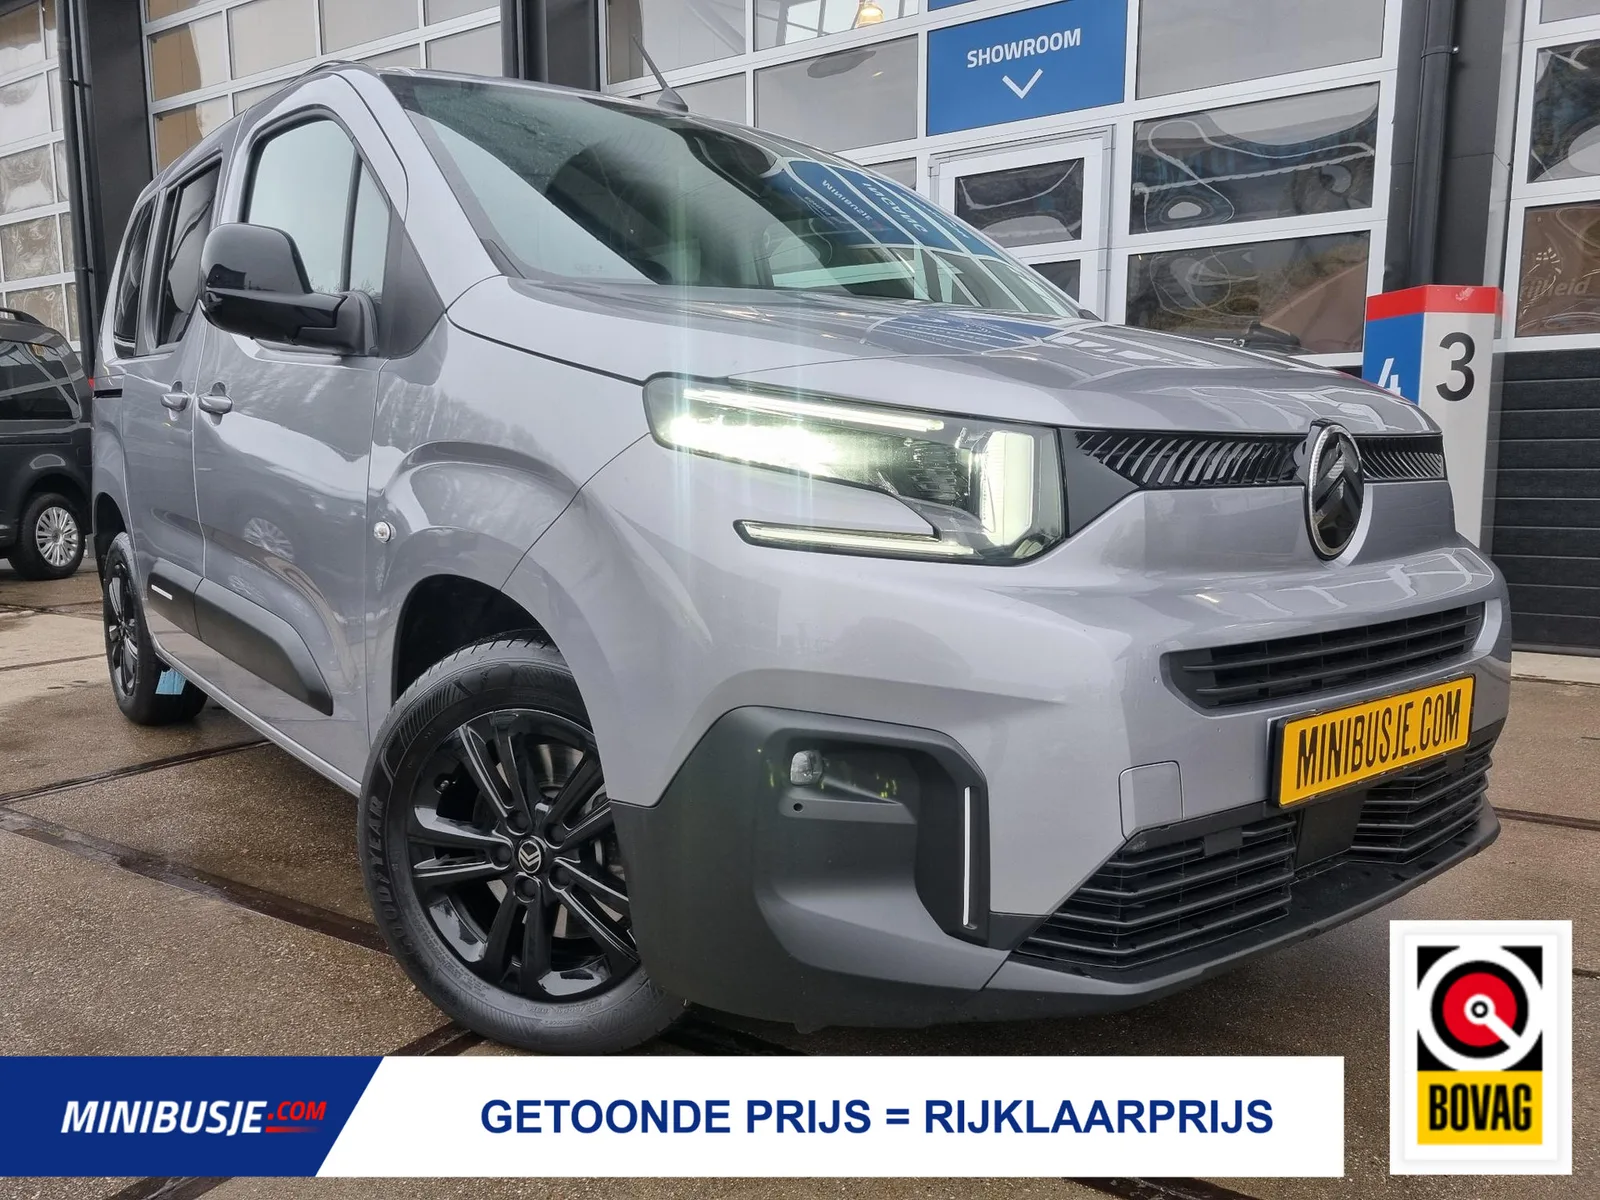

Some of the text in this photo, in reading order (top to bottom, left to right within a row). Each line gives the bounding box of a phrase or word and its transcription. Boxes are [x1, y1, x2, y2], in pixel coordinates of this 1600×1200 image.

[967, 28, 1081, 68] SHOWROOM
[1377, 357, 1401, 397] 4
[1436, 331, 1475, 401] 3
[1296, 688, 1461, 790] MINIBUSJE.COM
